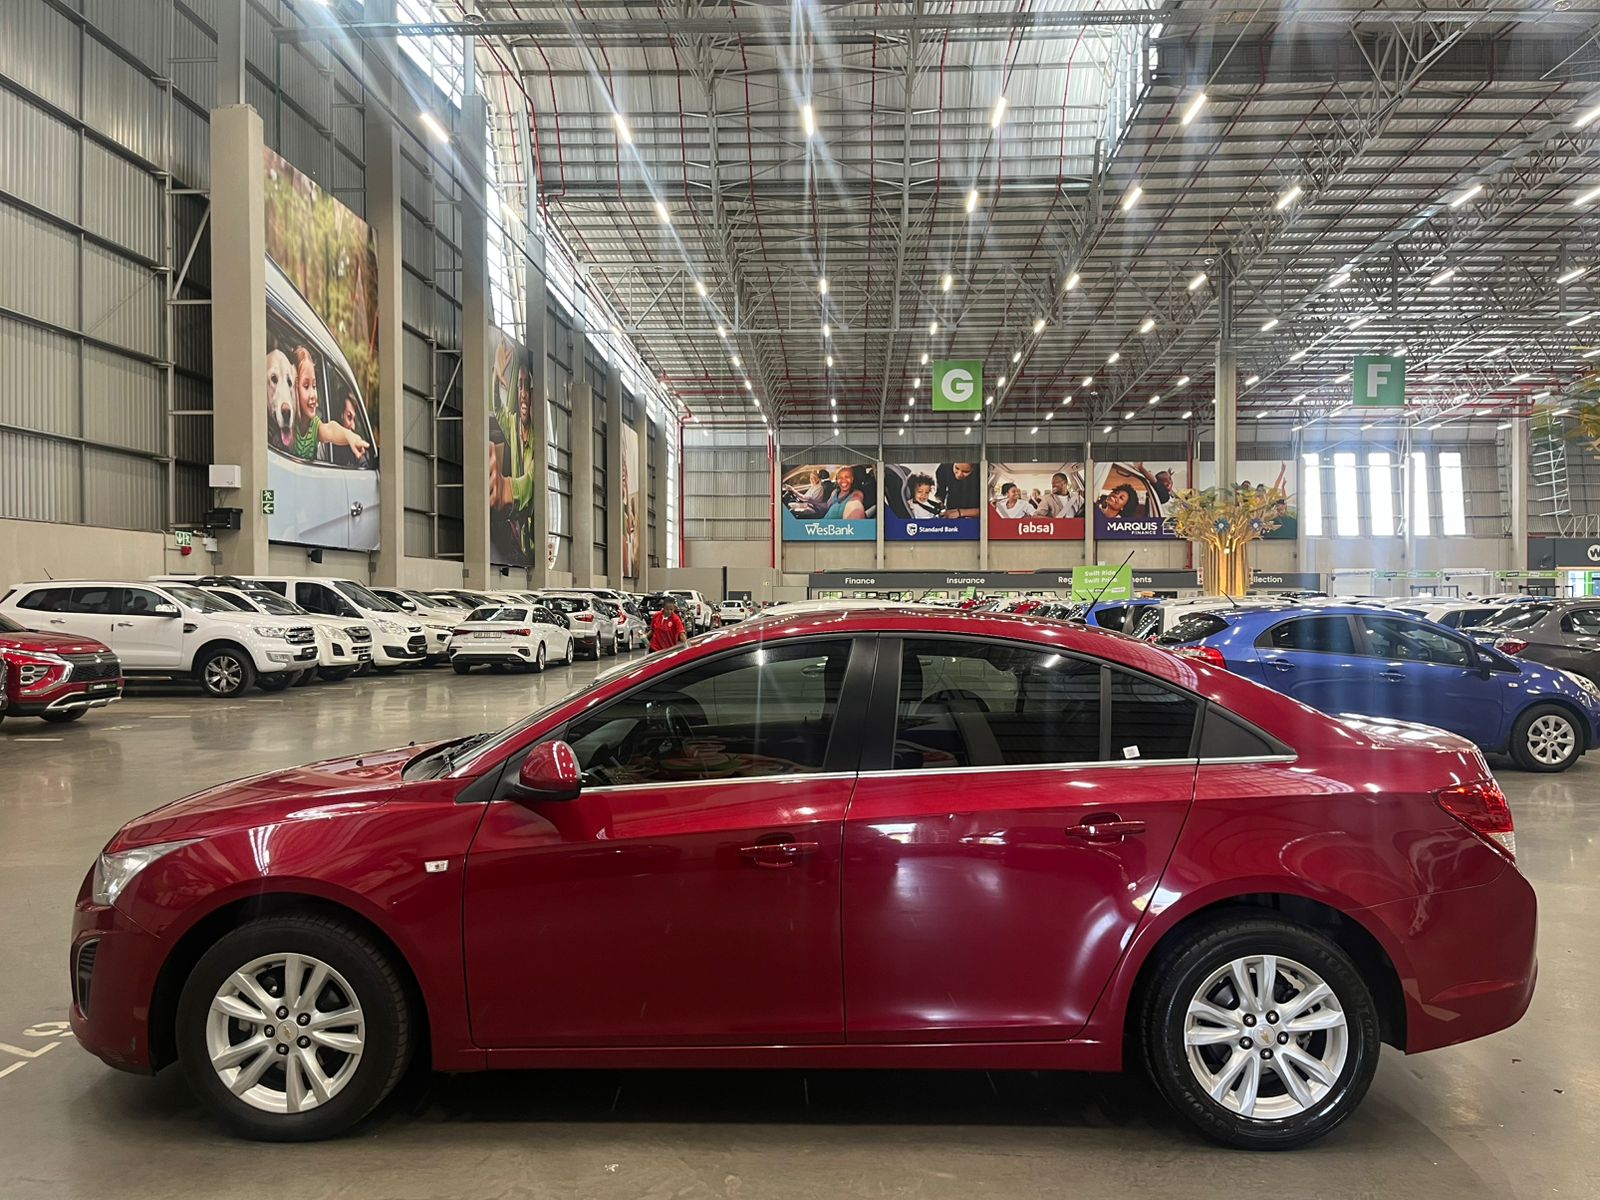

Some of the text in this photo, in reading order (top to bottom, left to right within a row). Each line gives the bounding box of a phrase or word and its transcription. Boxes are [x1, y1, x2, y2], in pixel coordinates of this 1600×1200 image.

[941, 368, 974, 403] G
[1366, 364, 1391, 398] F
[804, 522, 855, 536] WesBank
[919, 525, 959, 533] Standard Bank
[1018, 521, 1054, 536] (absa)
[1107, 521, 1157, 531] MARQUIS
[845, 577, 875, 585] Finance
[946, 577, 985, 585] Insurance
